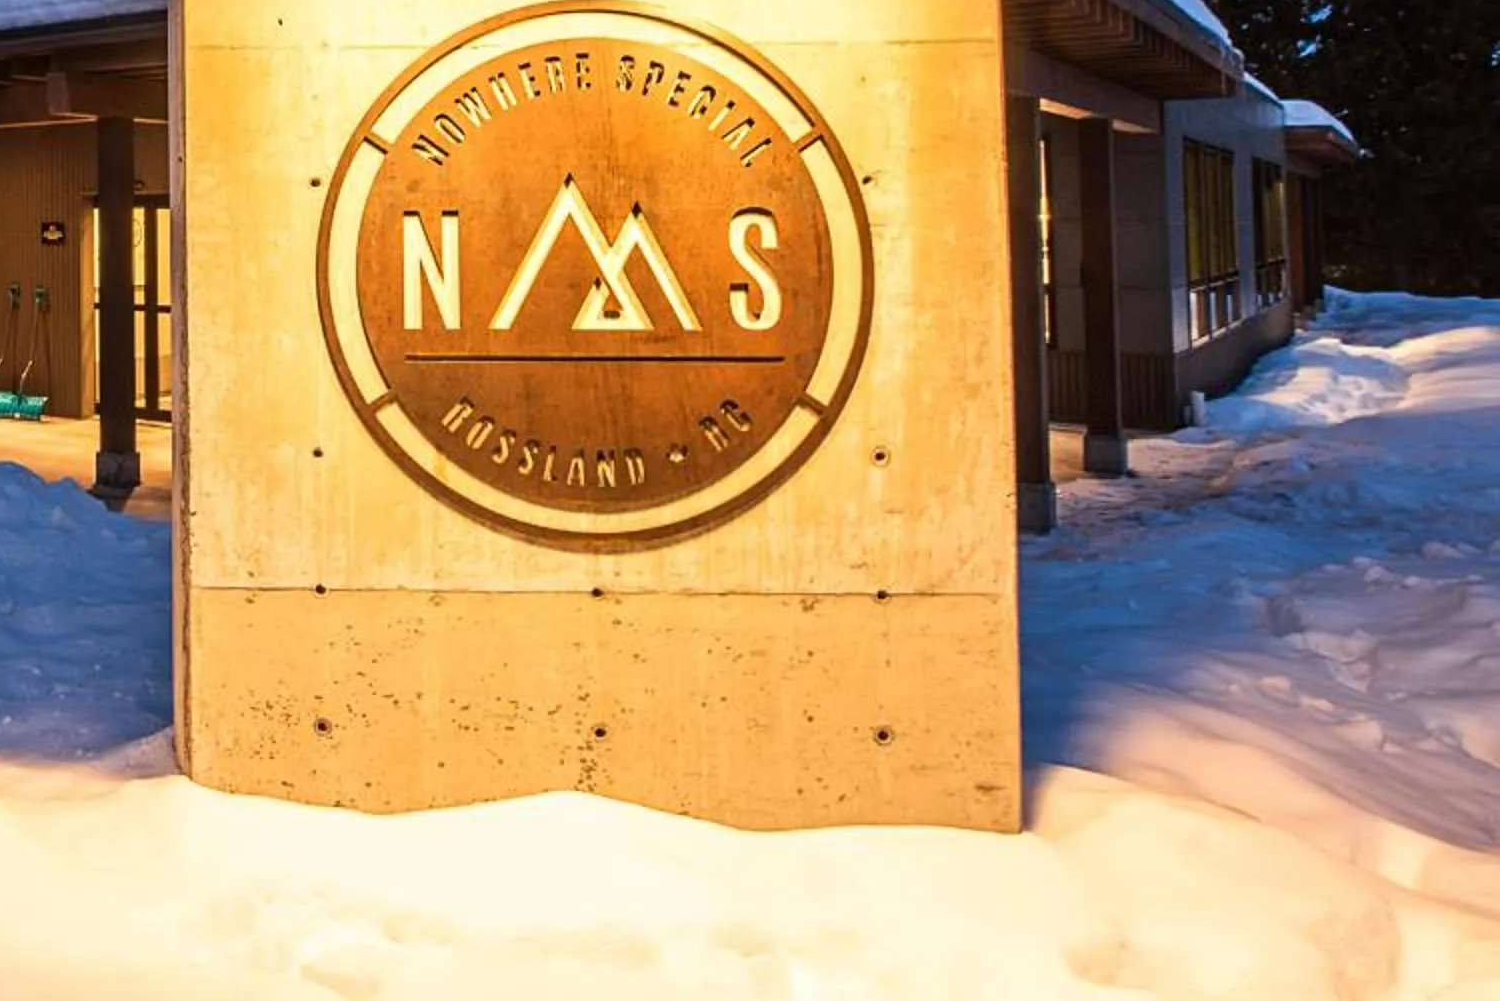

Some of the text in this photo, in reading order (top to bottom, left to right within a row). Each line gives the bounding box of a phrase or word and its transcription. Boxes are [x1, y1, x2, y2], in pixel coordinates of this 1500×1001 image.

[411, 52, 773, 168] NOWHERE SPECIAL
[440, 396, 646, 488] ROSSLAND
